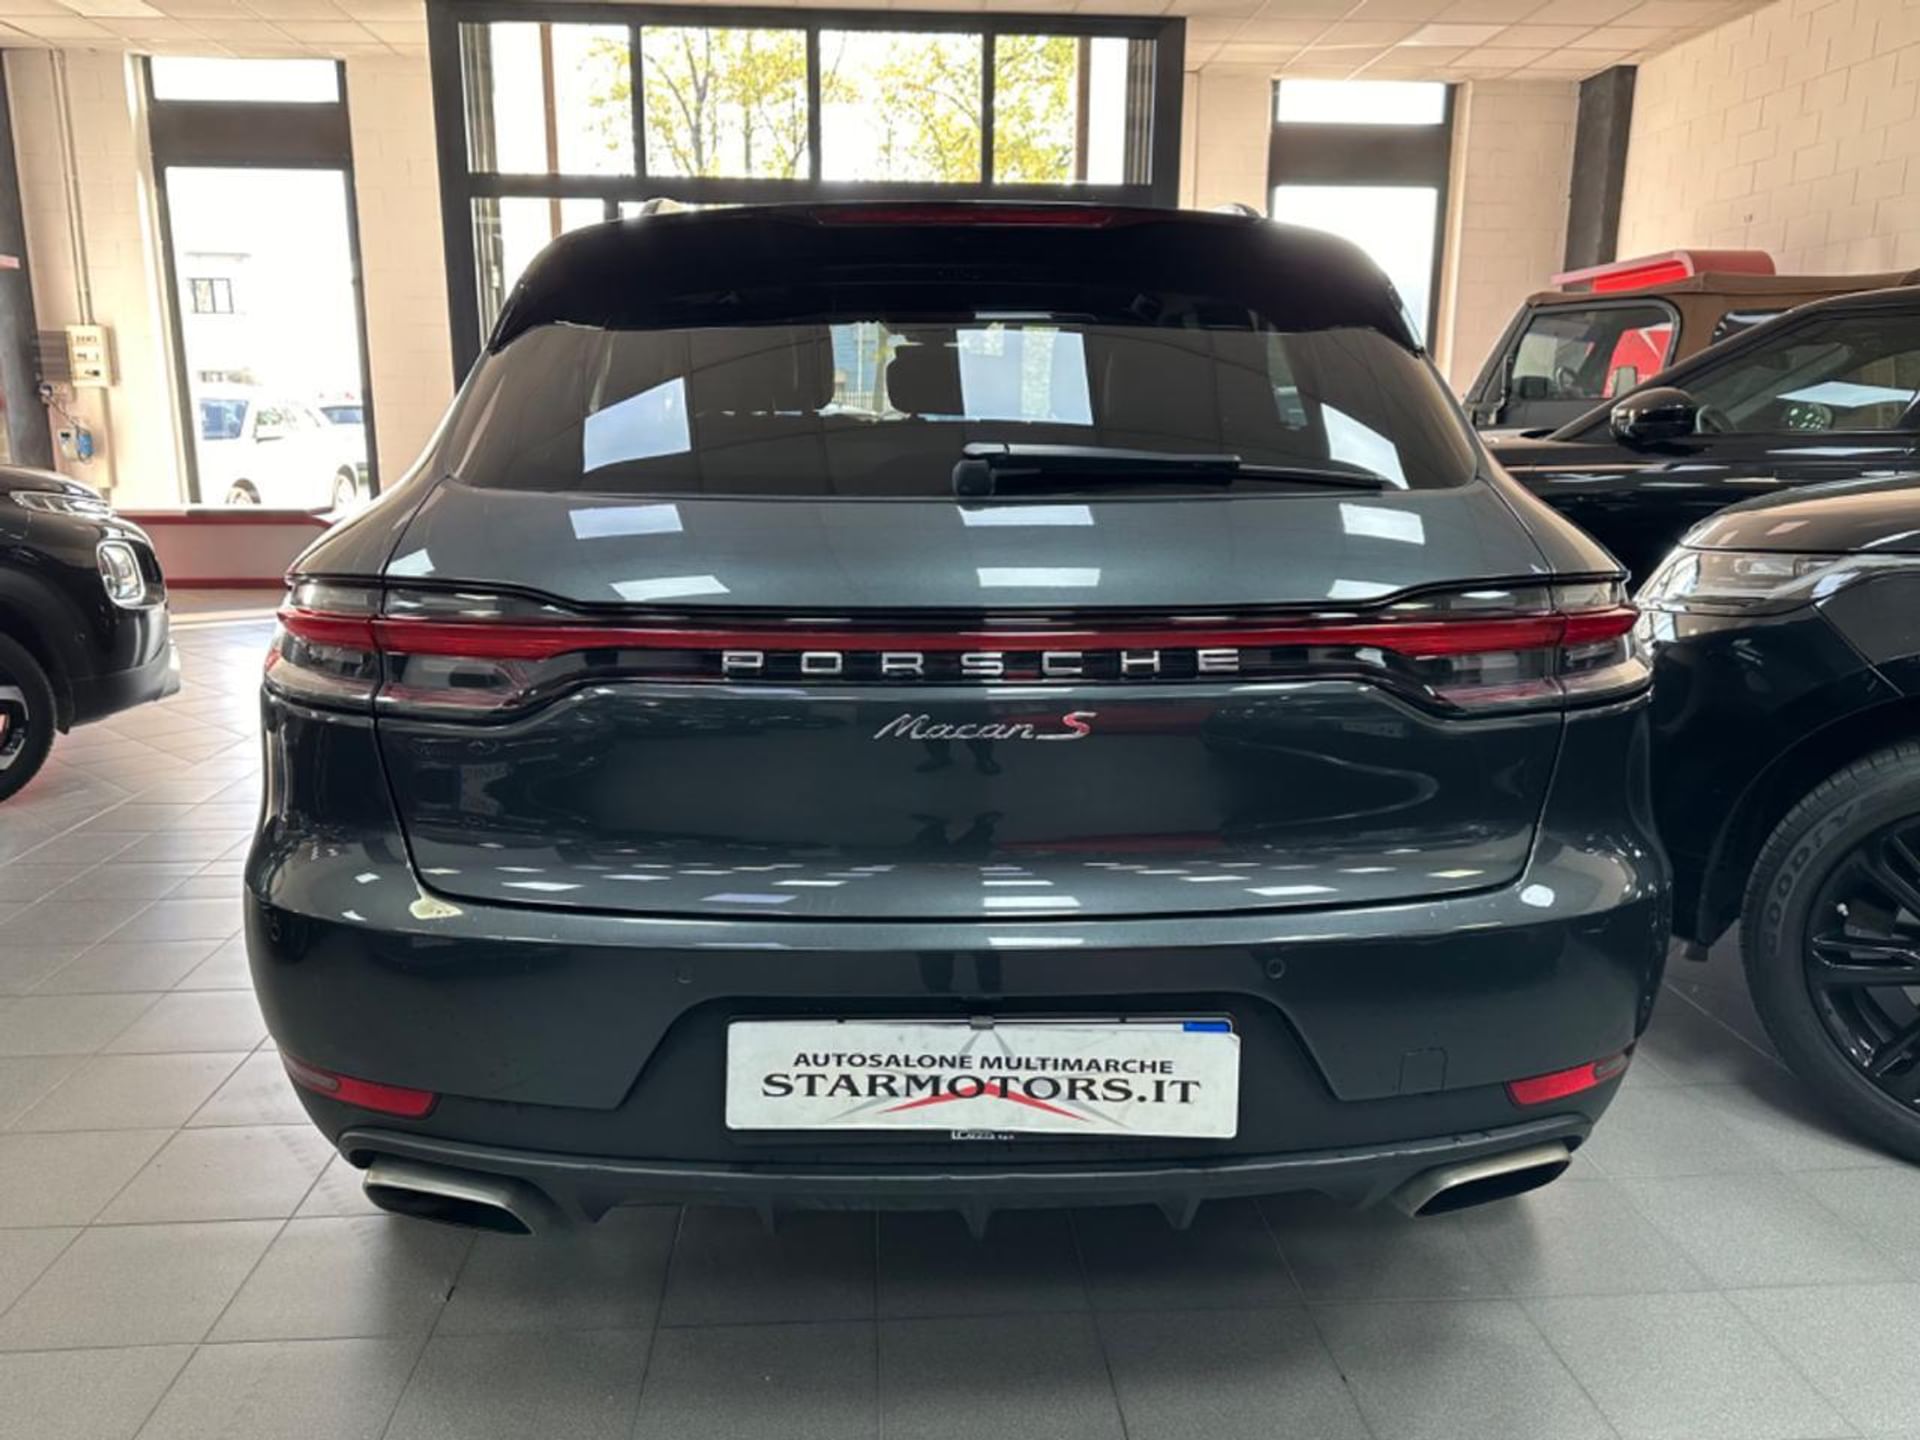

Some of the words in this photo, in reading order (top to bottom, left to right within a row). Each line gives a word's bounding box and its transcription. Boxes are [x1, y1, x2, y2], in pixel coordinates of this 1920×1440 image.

[721, 649, 1239, 674] PORSCHE
[874, 713, 1035, 740] Macan
[1037, 711, 1098, 740] S
[793, 1052, 973, 1070] AUTOSALONE
[980, 1056, 1173, 1074] MULTIMARCHE
[761, 1073, 1201, 1103] STARMOTORS.IT
